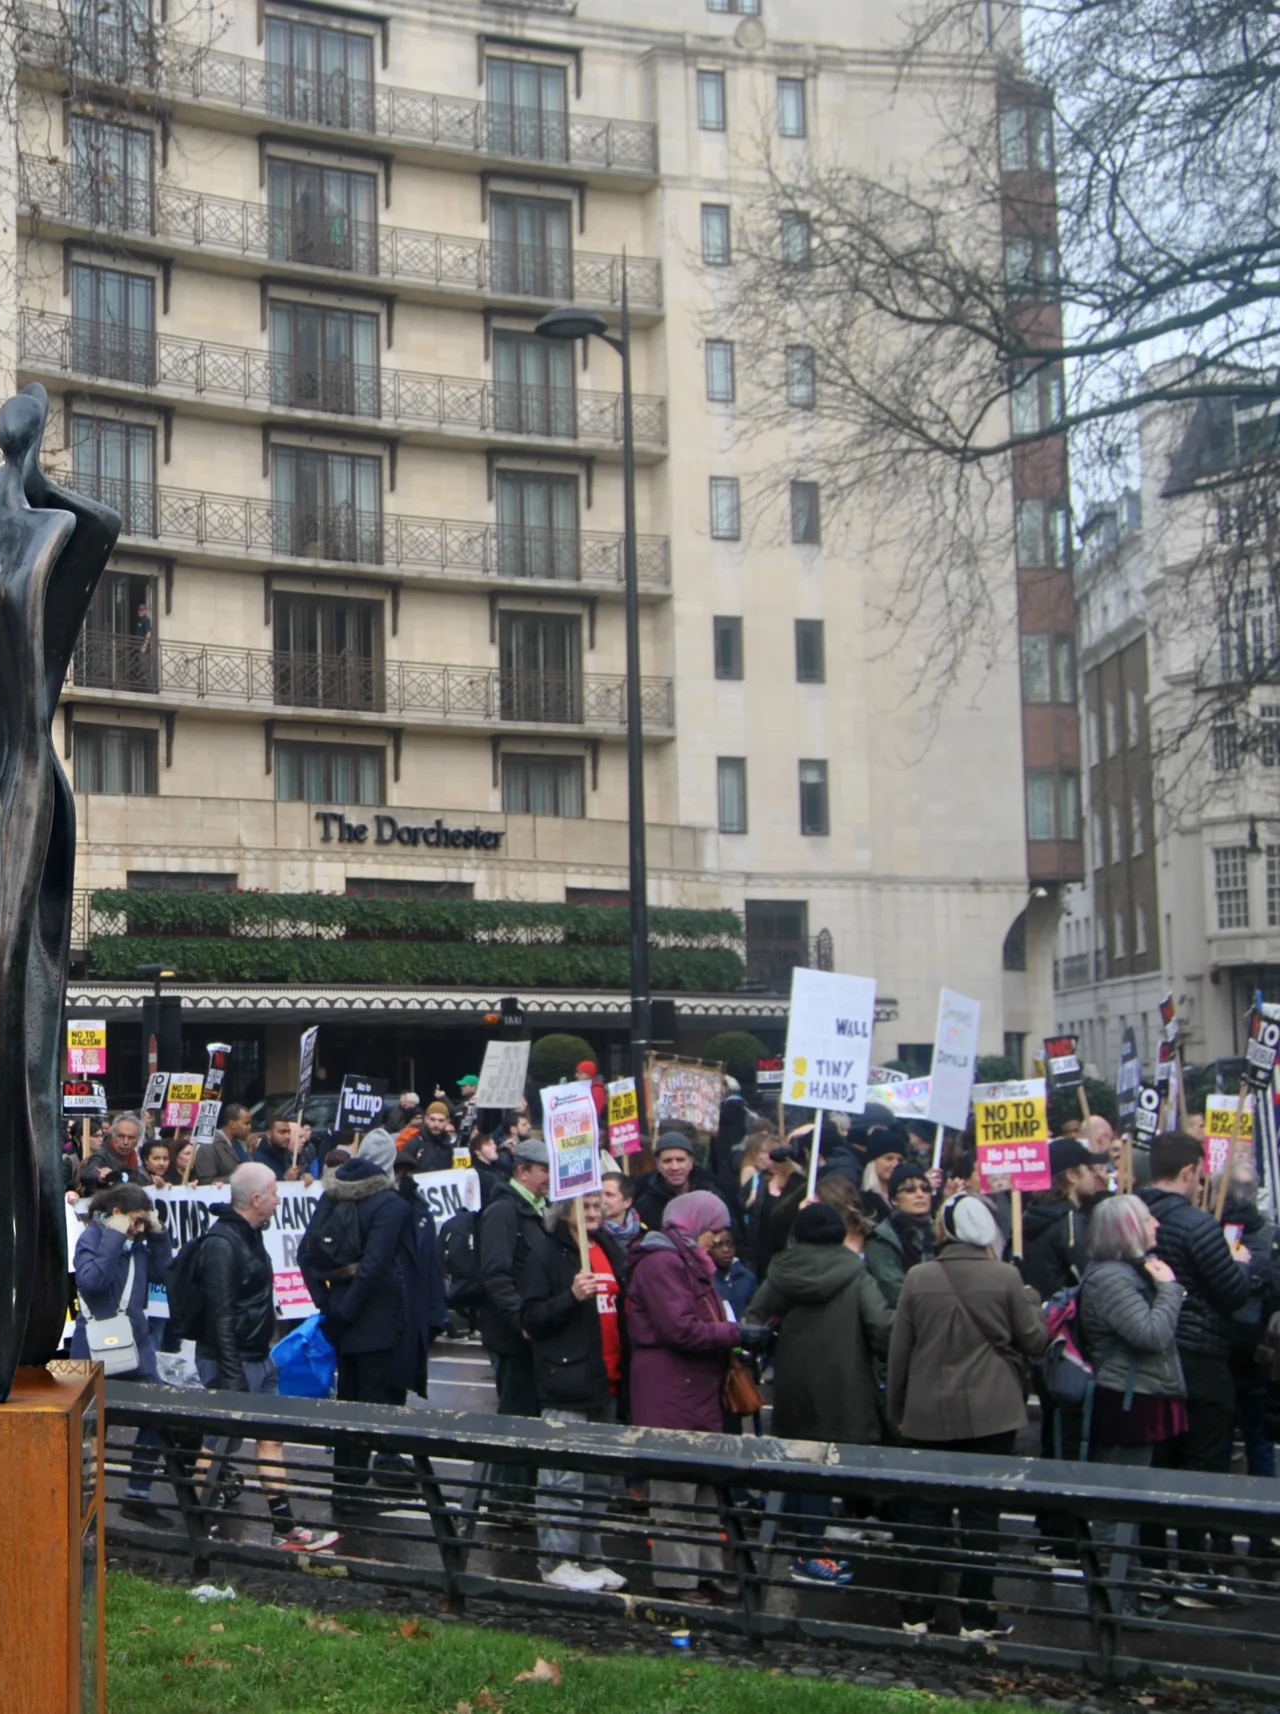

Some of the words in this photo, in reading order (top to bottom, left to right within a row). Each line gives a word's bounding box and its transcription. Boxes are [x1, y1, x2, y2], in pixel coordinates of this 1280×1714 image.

[315, 812, 368, 844] The
[374, 815, 506, 850] Dorchester
[504, 1016, 522, 1025] TAXI
[85, 1031, 95, 1039] TO
[836, 1018, 869, 1038] WALL
[1257, 1021, 1280, 1047] TO
[71, 1038, 101, 1046] RACISM
[71, 1064, 100, 1072] TRUMP
[758, 1059, 781, 1070] NO
[815, 1060, 854, 1078] TINY
[871, 1068, 885, 1079] NO
[885, 1072, 903, 1082] TO
[65, 1083, 89, 1095] NO
[92, 1084, 105, 1095] TO
[357, 1082, 365, 1091] No
[365, 1084, 371, 1092] to
[809, 1082, 859, 1103] HANDS
[344, 1087, 383, 1117] Trump
[612, 1098, 622, 1108] NO
[624, 1094, 633, 1104] TO
[348, 1114, 356, 1123] No
[611, 1105, 635, 1122] TRUMP
[984, 1104, 1007, 1122] NO
[1012, 1101, 1035, 1119] TO
[1211, 1111, 1229, 1123] NO
[167, 1117, 191, 1126] TRUMP
[981, 1120, 1041, 1140] TRUMP
[1209, 1139, 1229, 1151] NO
[987, 1147, 1003, 1161] No
[1004, 1147, 1016, 1160] to
[1017, 1146, 1037, 1160] the
[1210, 1151, 1228, 1163] TO
[568, 1161, 585, 1175] NOT
[981, 1160, 1022, 1175] Muslim
[1023, 1159, 1046, 1172] ban
